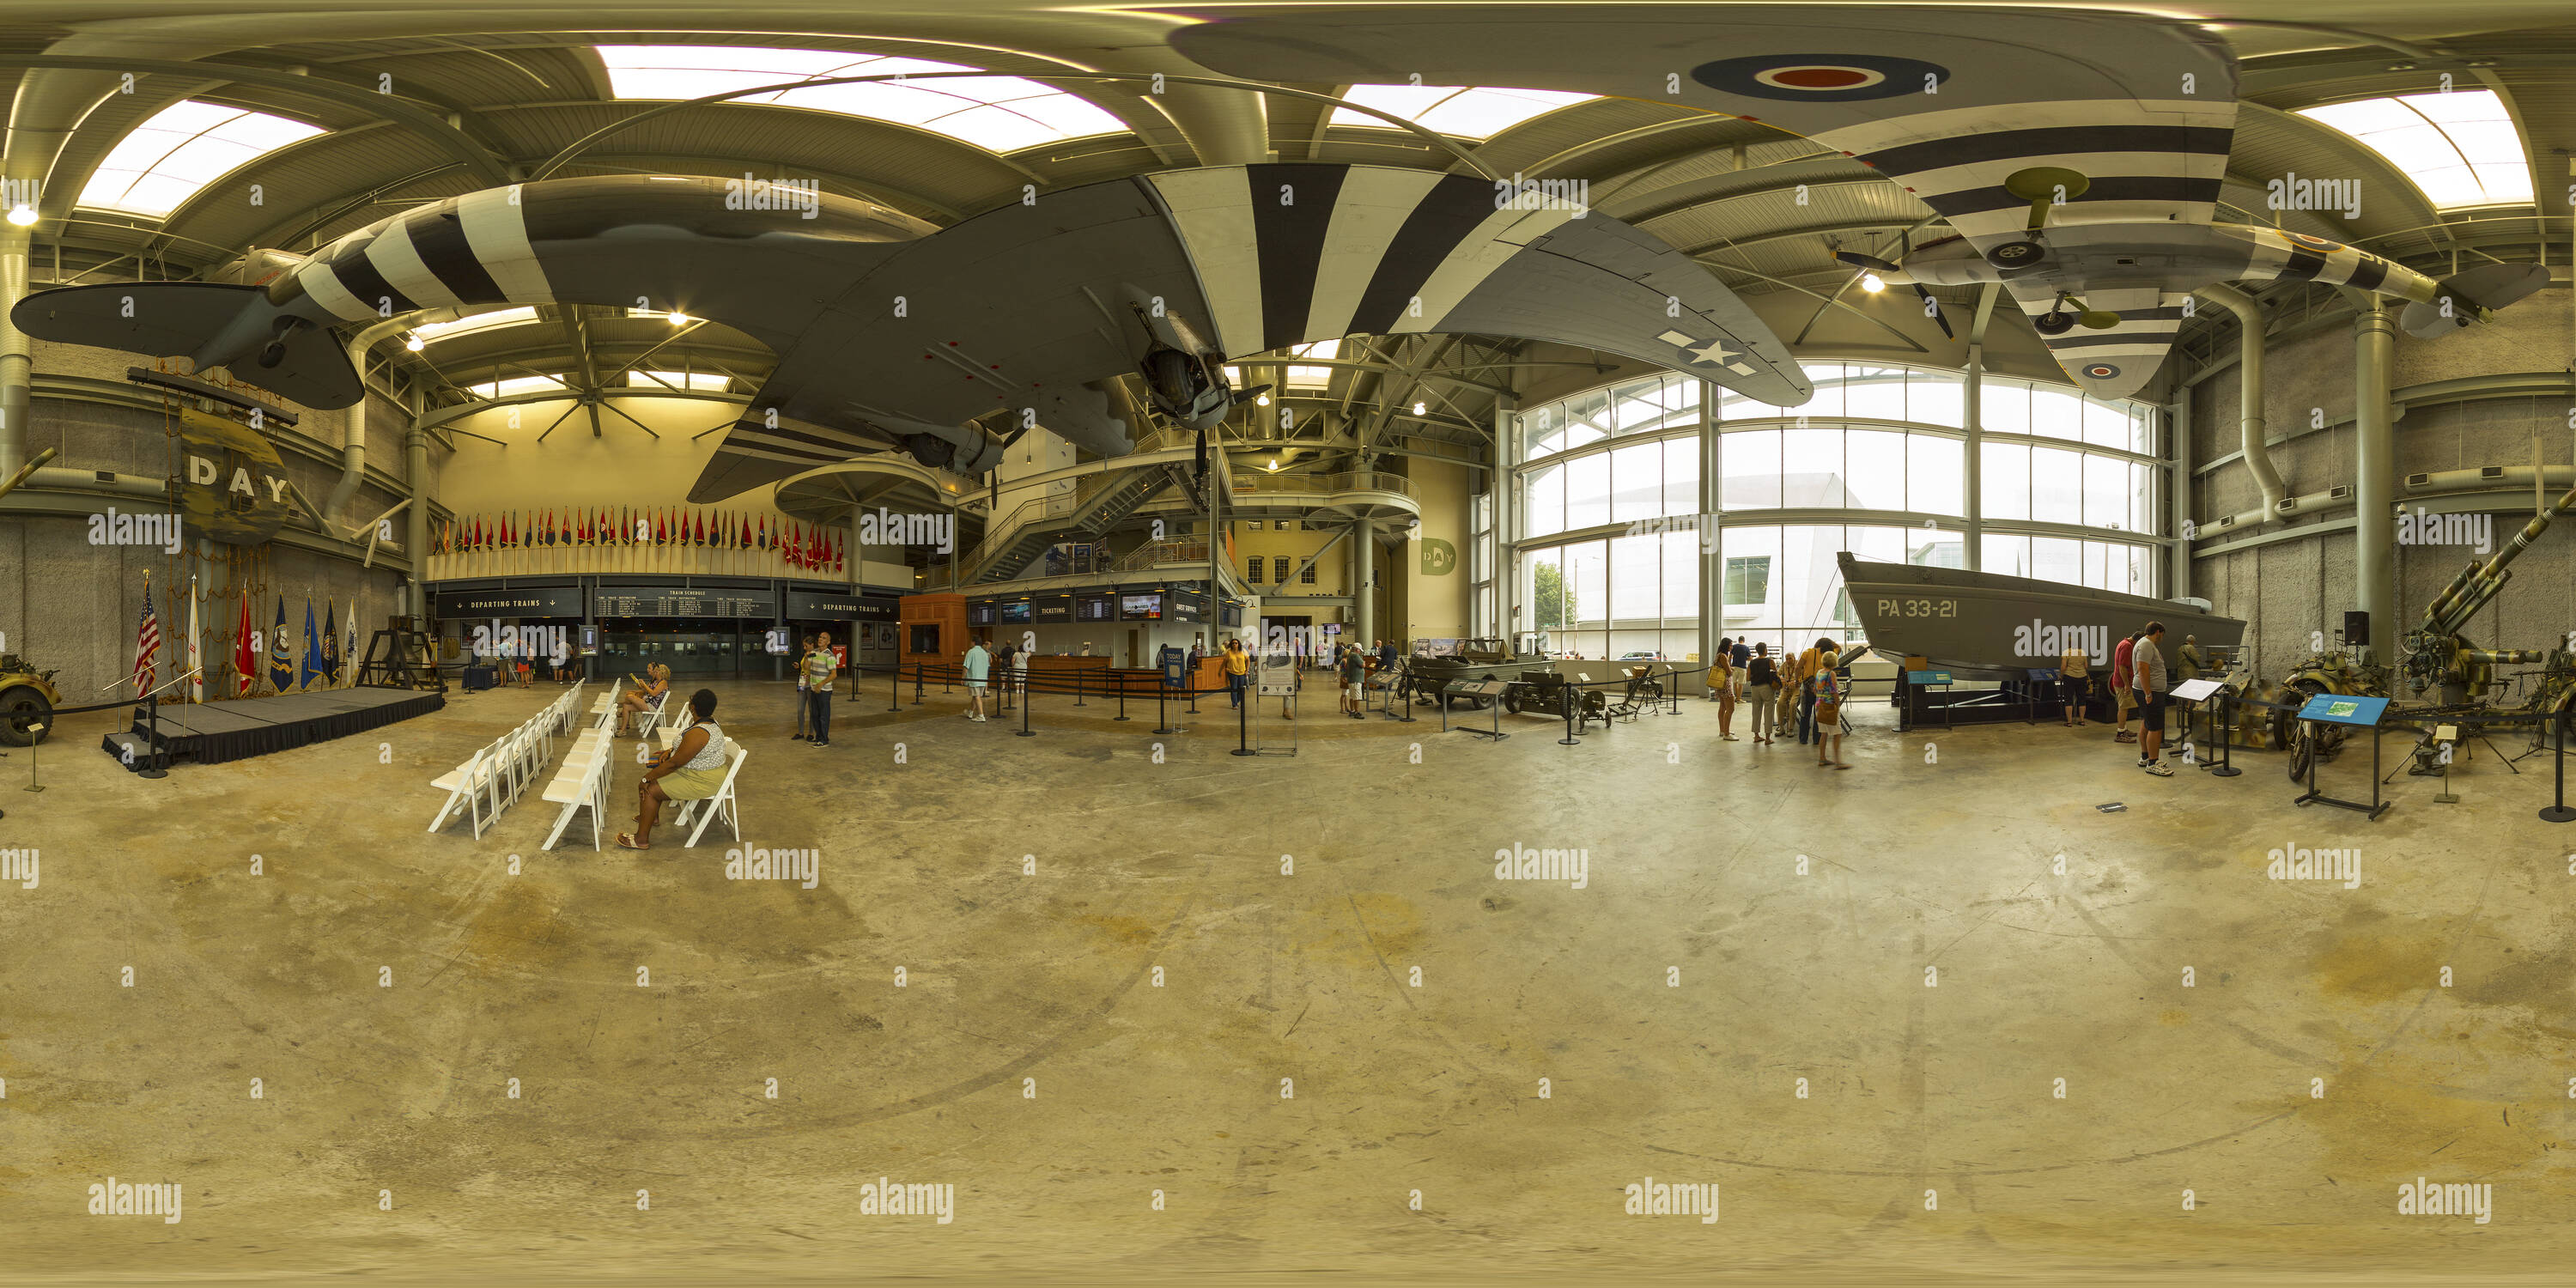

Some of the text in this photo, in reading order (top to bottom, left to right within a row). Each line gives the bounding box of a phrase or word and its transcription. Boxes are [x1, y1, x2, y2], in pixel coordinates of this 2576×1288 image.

[190, 455, 288, 502] DAY
[1423, 551, 1453, 562] DAY
[471, 600, 510, 609] DEPARTING
[823, 604, 880, 613] DEPARTING TRAINS
[1878, 599, 1957, 617] PA 33-21
